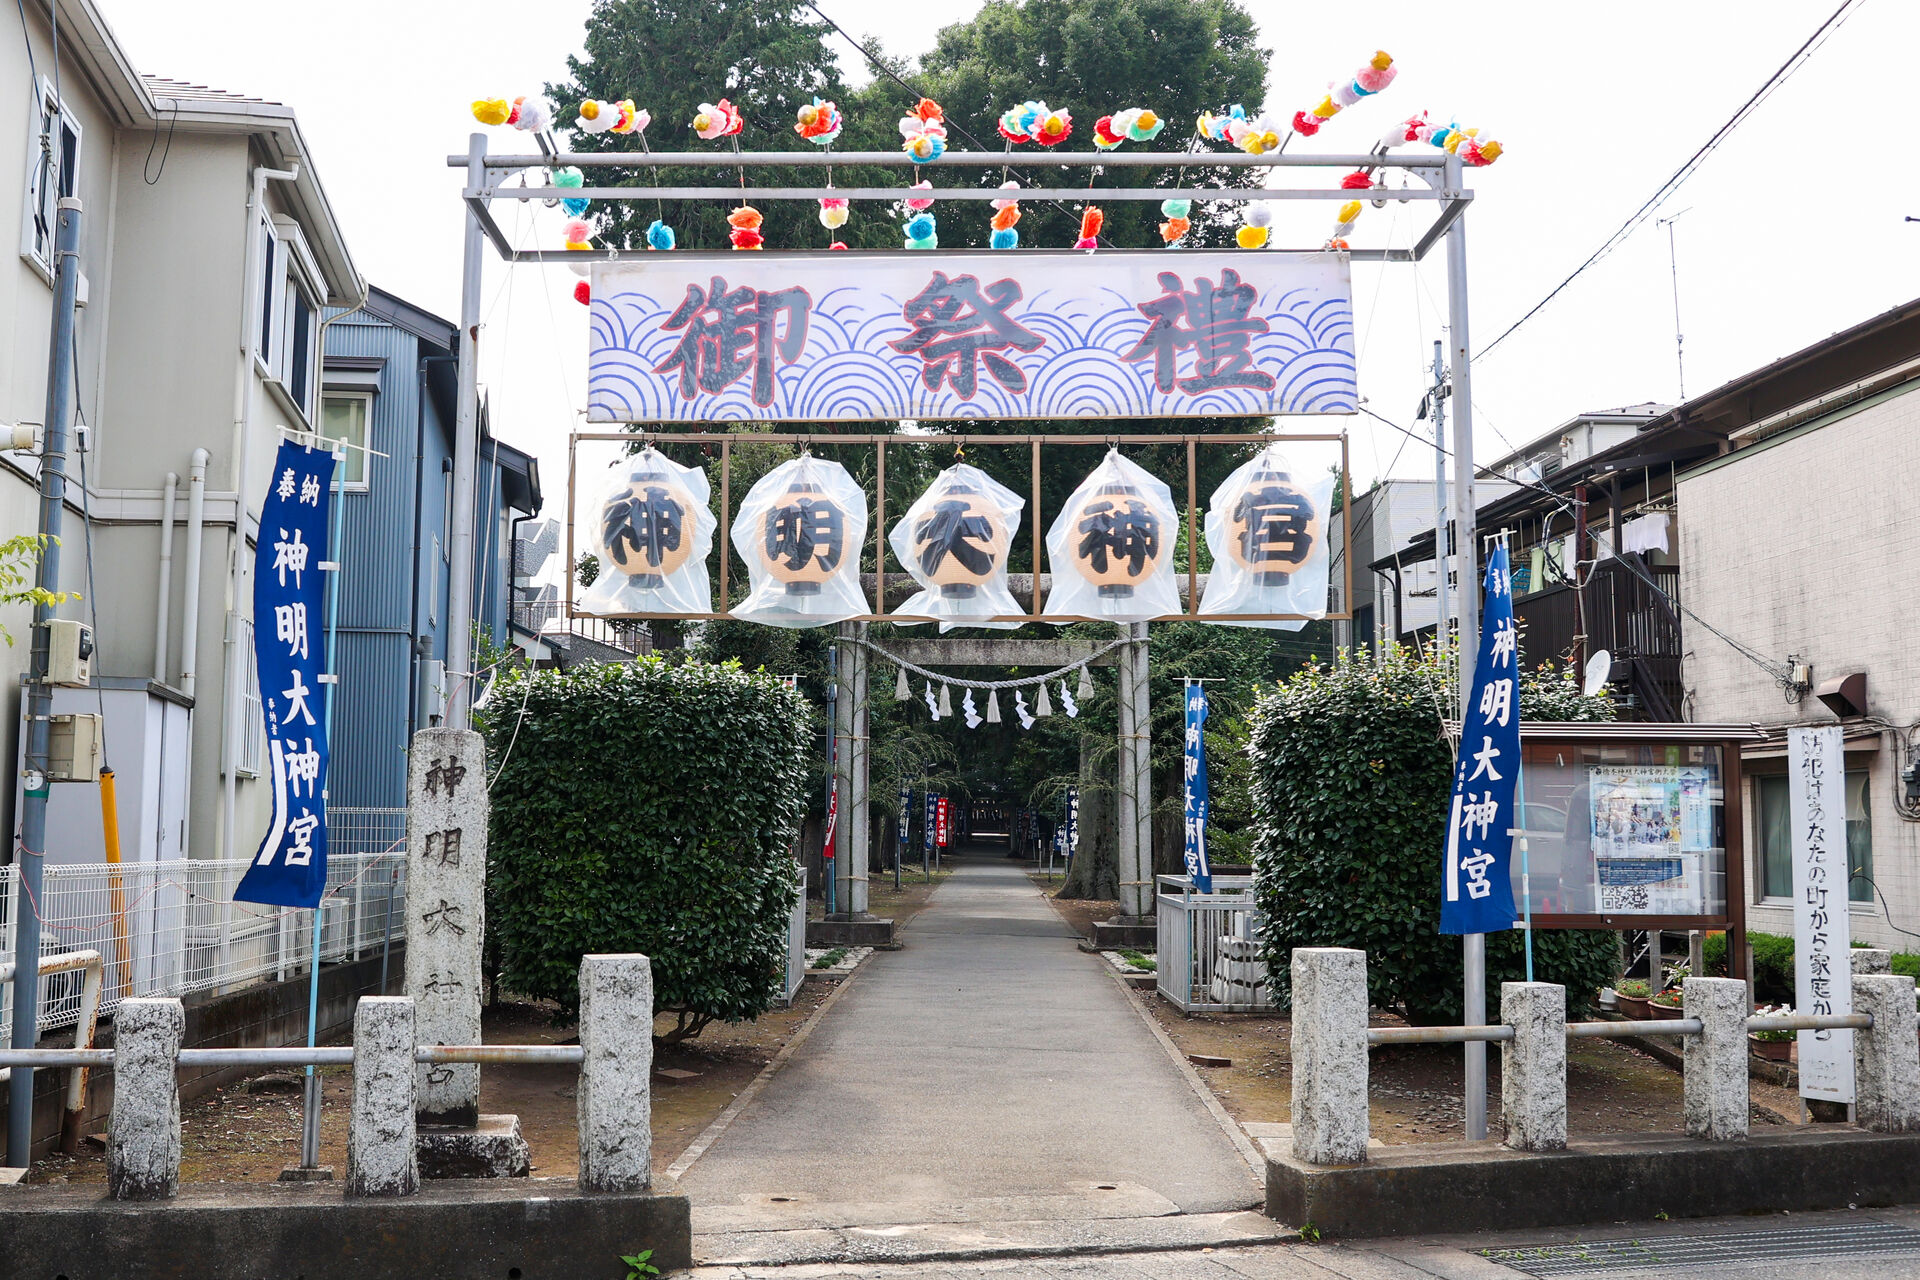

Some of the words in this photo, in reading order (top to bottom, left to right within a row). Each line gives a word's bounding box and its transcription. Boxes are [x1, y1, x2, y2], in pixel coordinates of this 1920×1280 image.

[650, 268, 1276, 408] 御祭禮
[276, 467, 320, 507] 奉納
[273, 527, 320, 866] 神明大神宮
[1461, 617, 1515, 899] 神明大神宮
